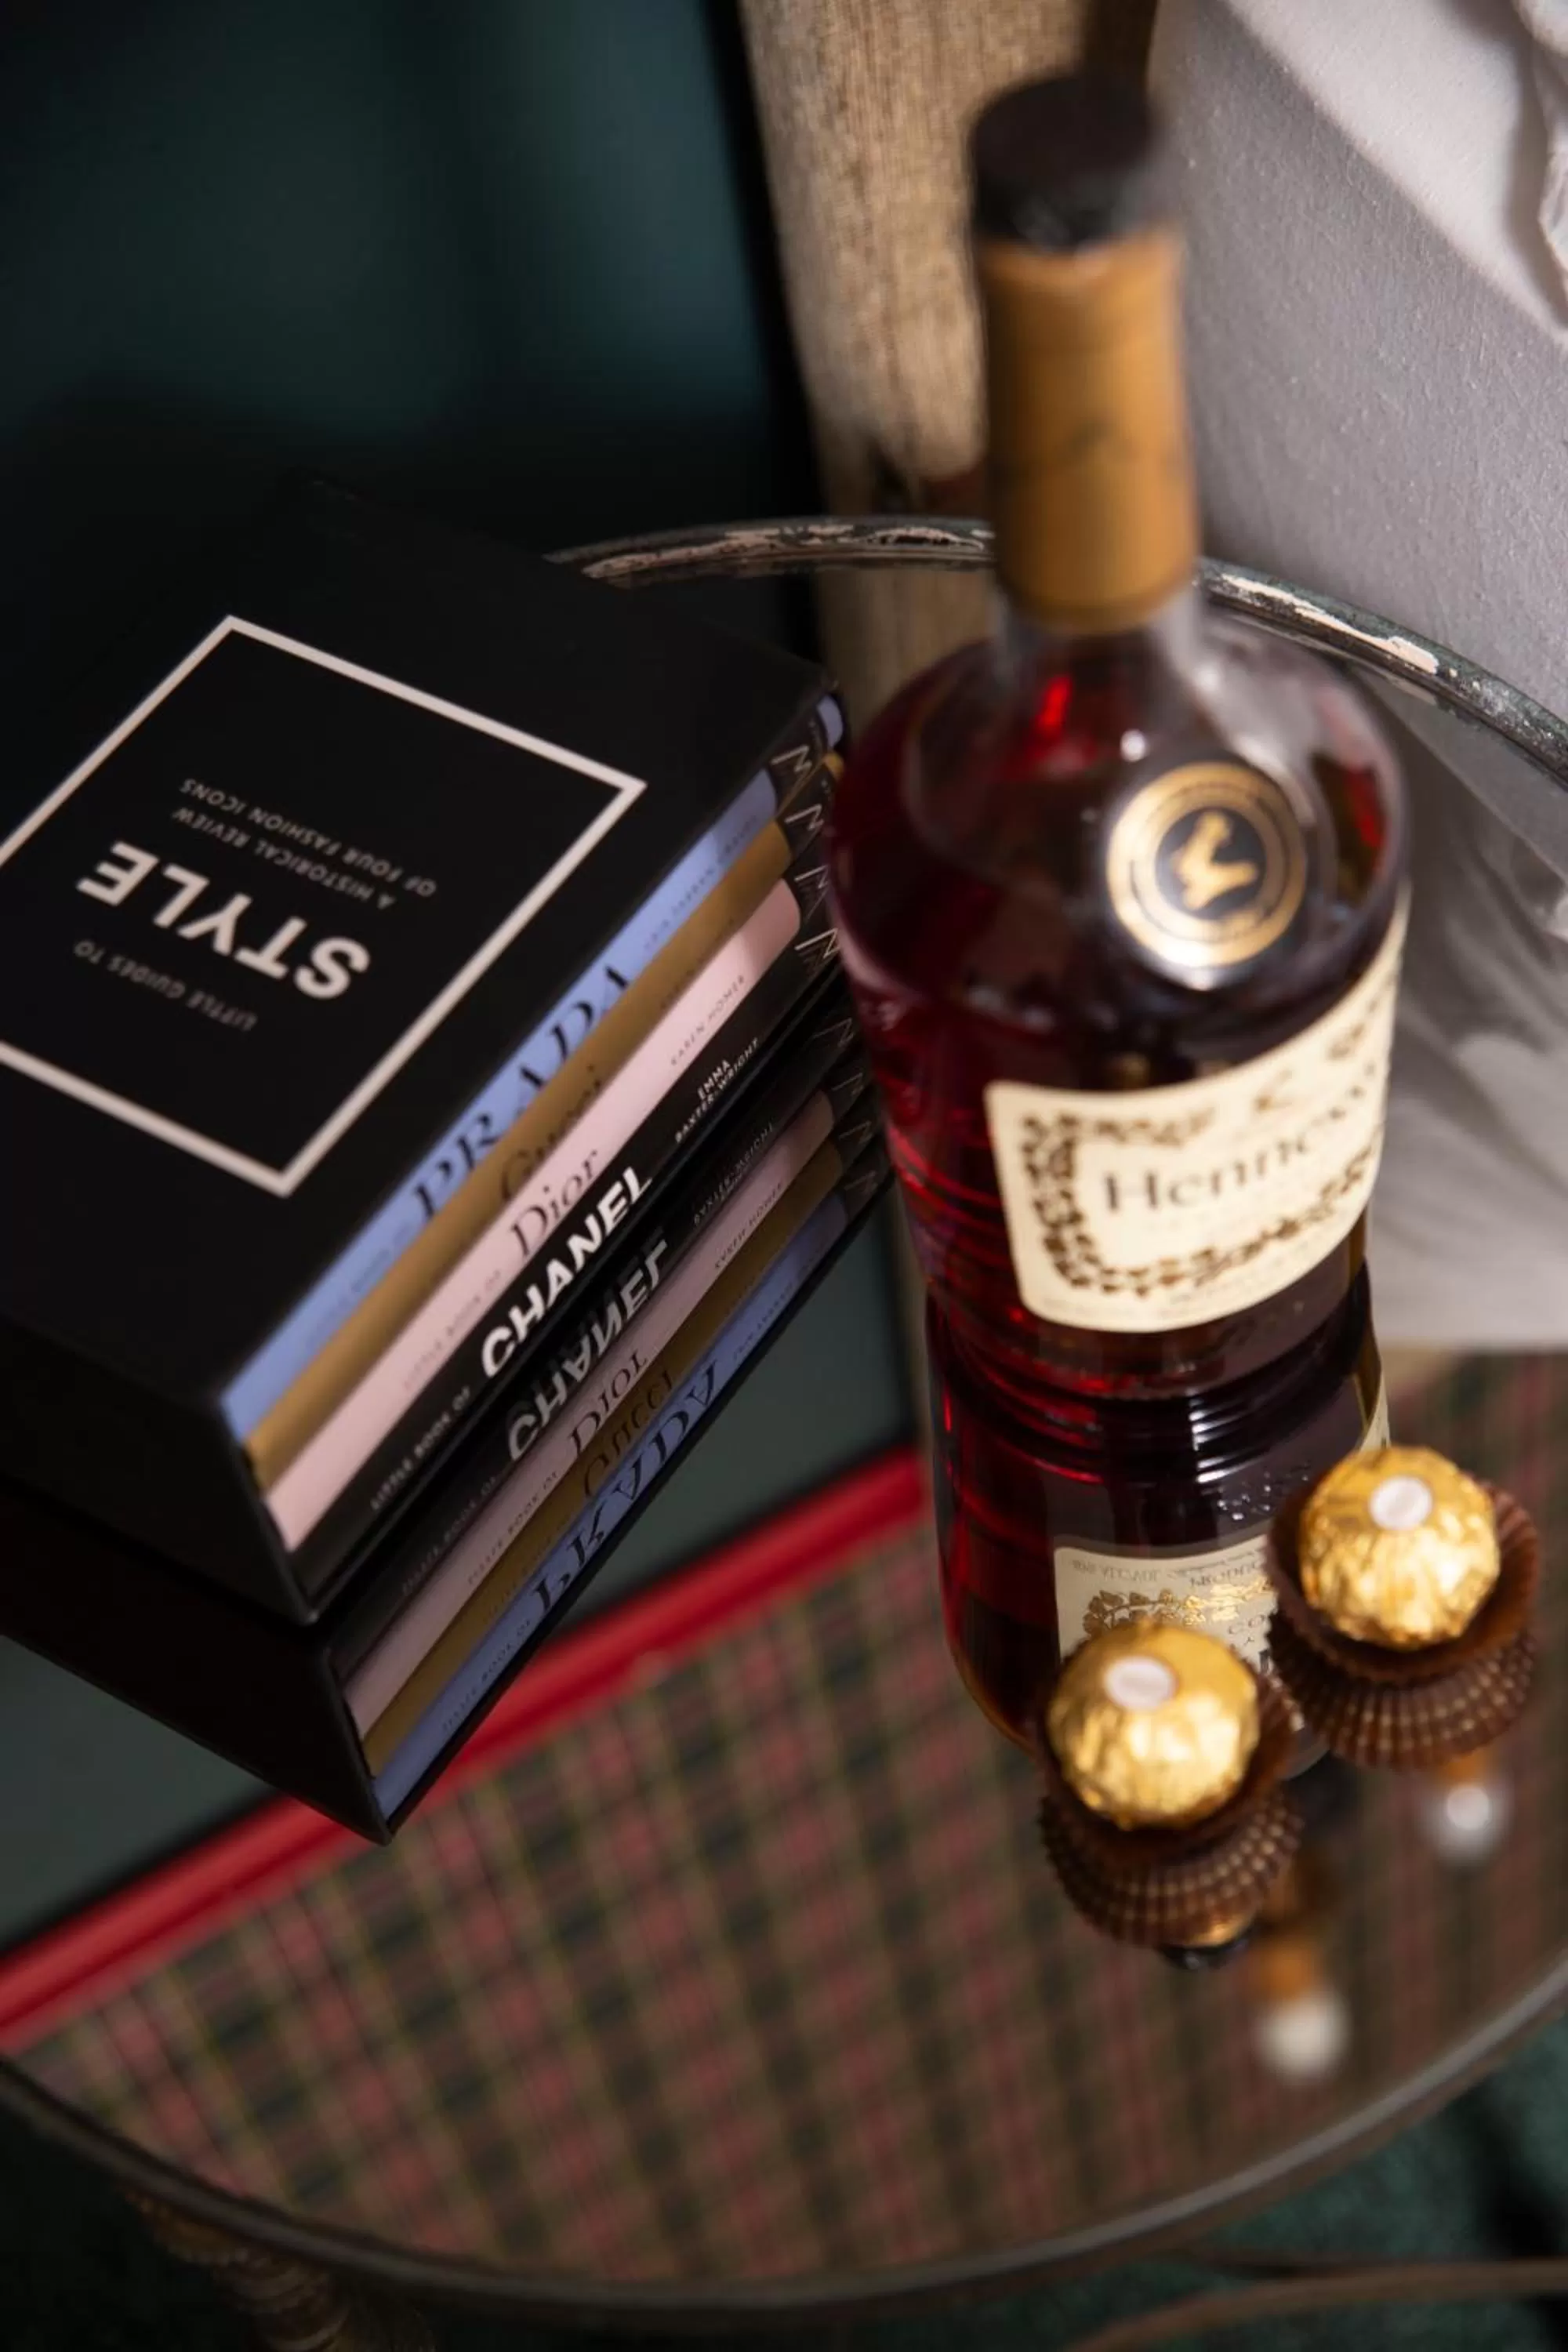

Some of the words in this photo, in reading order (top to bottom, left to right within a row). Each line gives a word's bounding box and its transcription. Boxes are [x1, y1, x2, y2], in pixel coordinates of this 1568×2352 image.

[178, 778, 243, 814] ICONS
[171, 807, 252, 848] REVIEW
[247, 800, 341, 857] FASHION
[254, 840, 375, 902] HISTORICAL
[341, 847, 404, 883] FOUR
[404, 877, 438, 898] OF
[76, 840, 371, 1000] STYLE
[376, 894, 397, 910] A
[74, 939, 104, 964] TO
[107, 953, 186, 1000] GUIDES
[412, 966, 631, 1222] PRADA
[696, 1057, 731, 1100] EMMA
[509, 1149, 597, 1259] Dior
[481, 1166, 653, 1377] CHANEL
